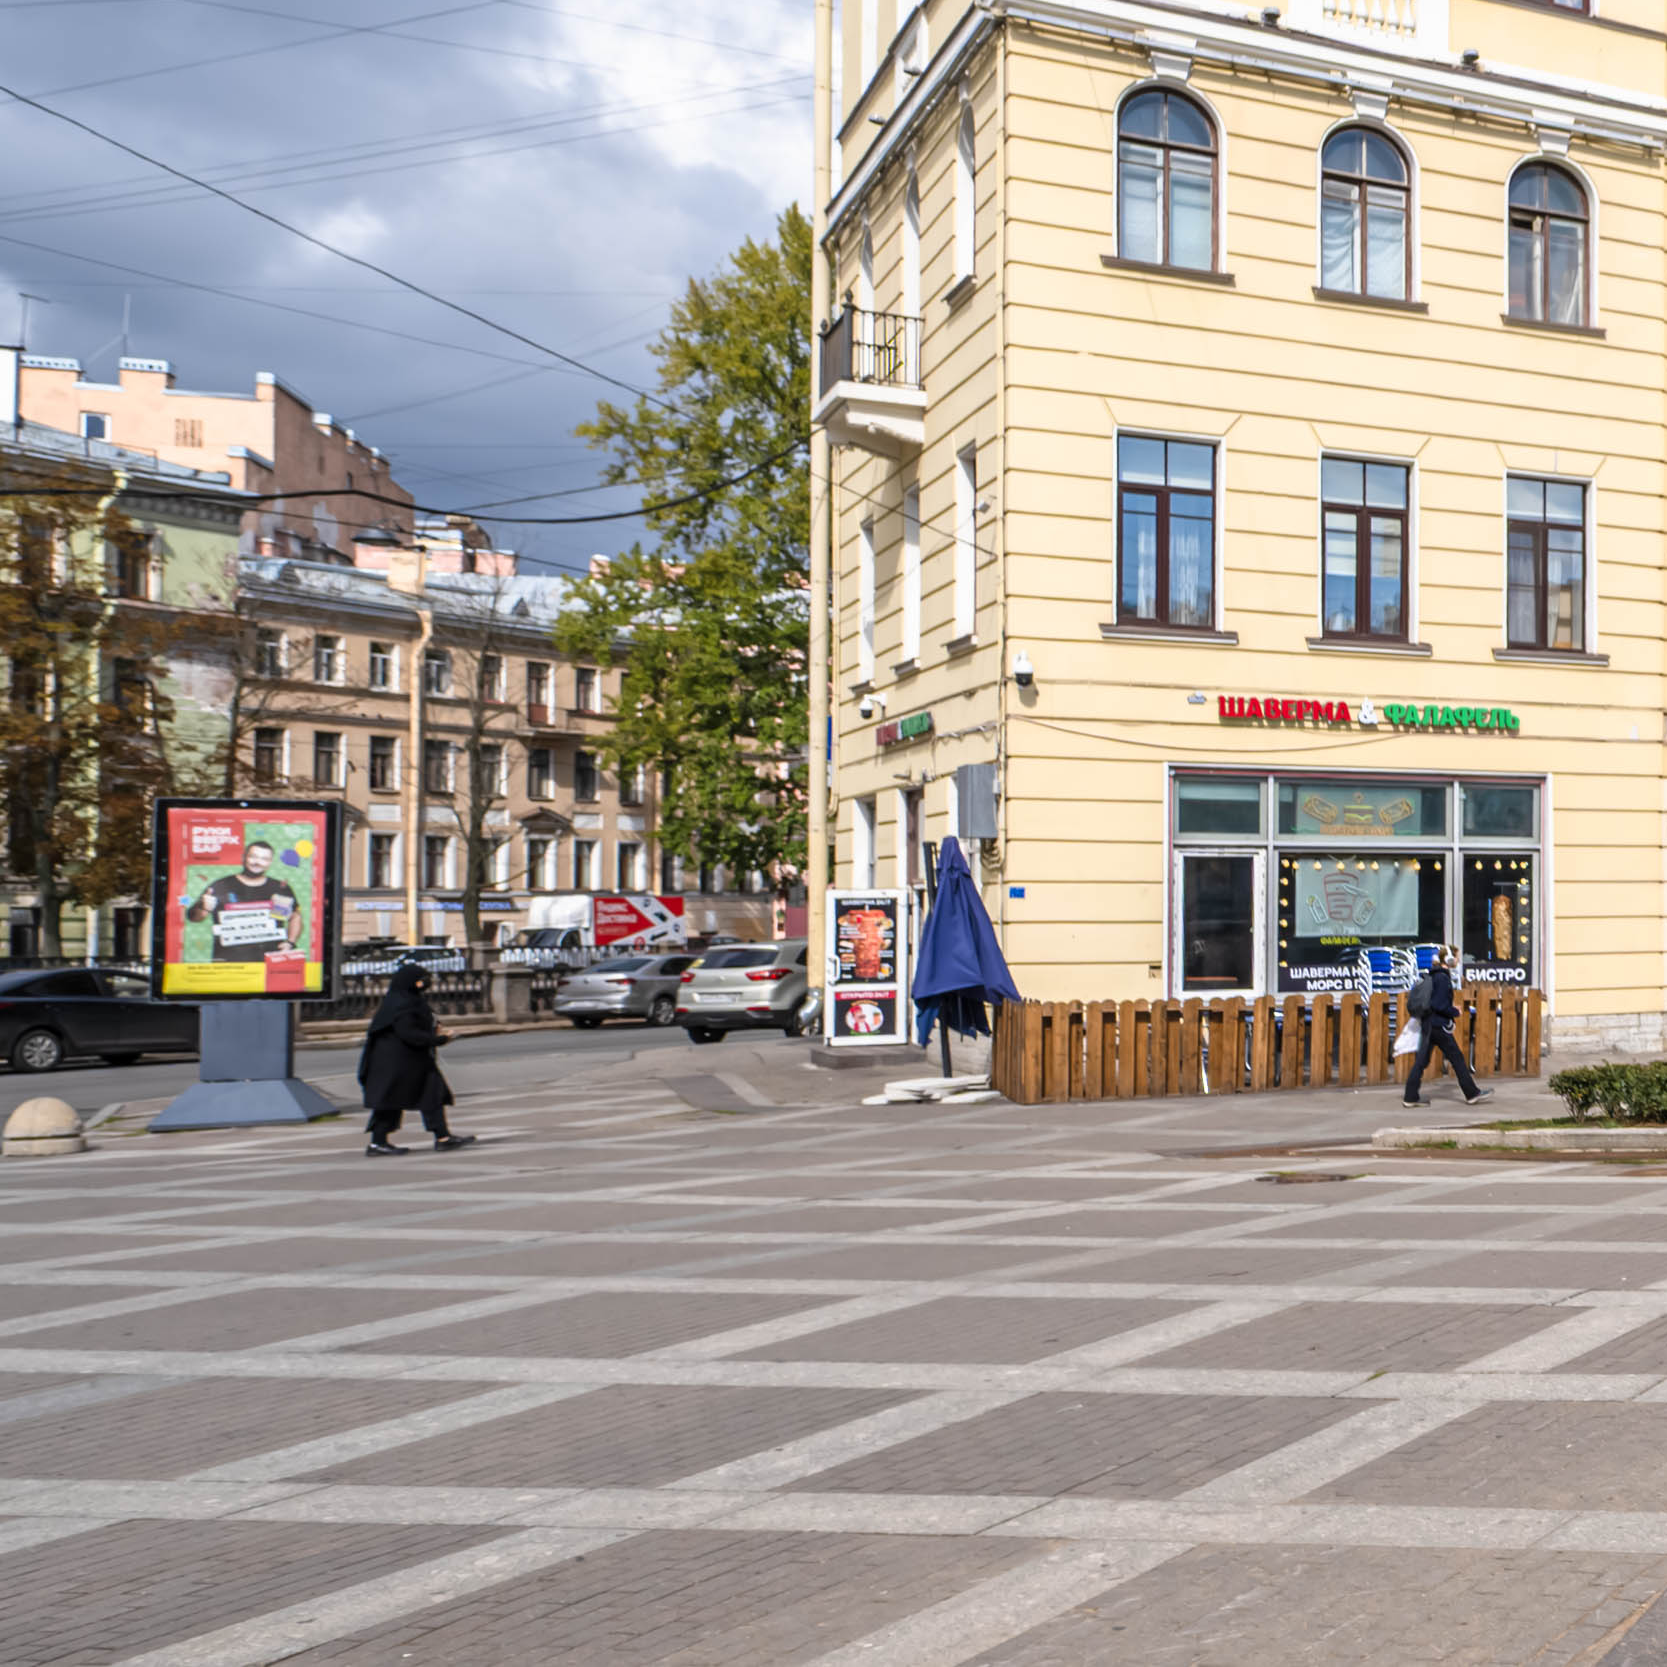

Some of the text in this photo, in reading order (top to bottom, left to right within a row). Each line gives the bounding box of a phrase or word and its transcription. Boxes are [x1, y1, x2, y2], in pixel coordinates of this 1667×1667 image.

[1217, 695, 1351, 723] ШАВЕРМА
[1358, 696, 1379, 725] &
[1384, 703, 1521, 730] ФАЛАФЕЛЬ
[1290, 966, 1350, 979] ШАВЕРМА
[1465, 967, 1527, 982] БИСТРО
[1307, 980, 1343, 990] МОРС
